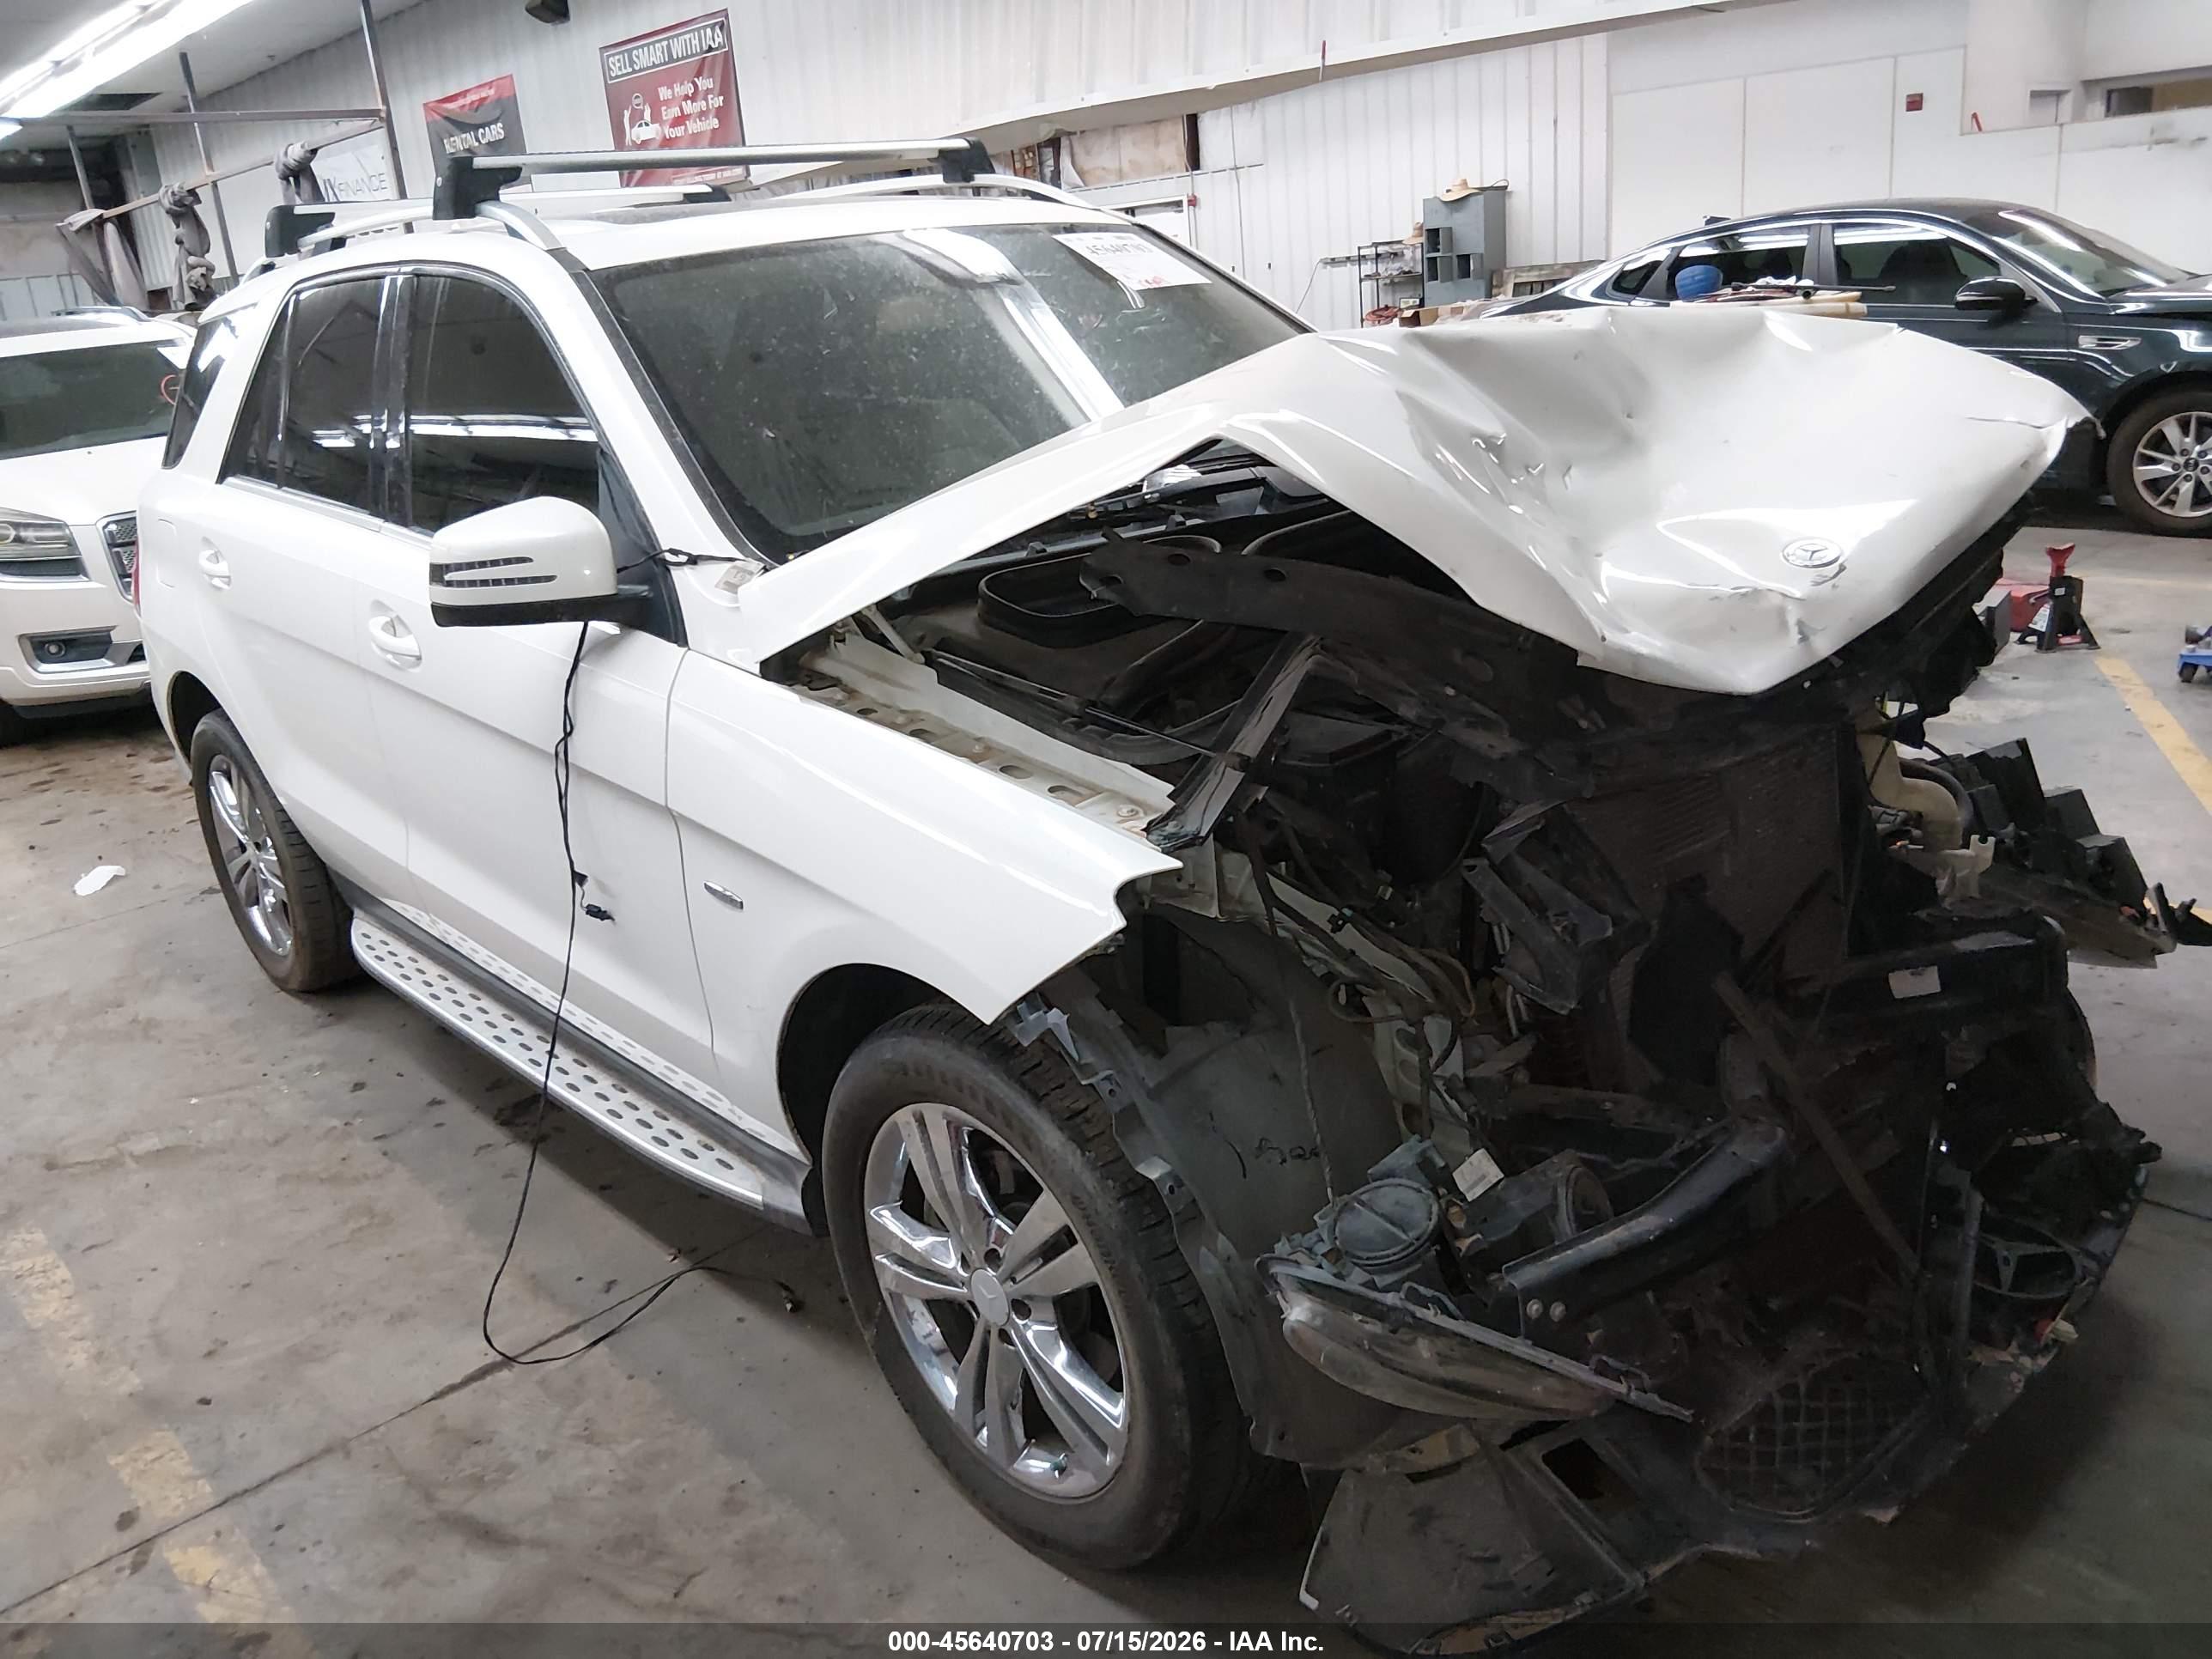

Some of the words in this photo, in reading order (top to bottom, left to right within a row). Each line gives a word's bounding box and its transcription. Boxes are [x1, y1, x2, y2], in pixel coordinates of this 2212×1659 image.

[608, 53, 633, 77] SELL
[632, 40, 669, 70] SMART
[669, 31, 701, 59] WITH
[700, 25, 724, 51] IAA
[657, 87, 672, 101] We
[673, 82, 695, 97] Help
[694, 76, 714, 92] You
[660, 105, 682, 120] Earn
[681, 100, 707, 114] More
[708, 94, 724, 108] For
[443, 131, 479, 155] RENTAL
[477, 122, 505, 144] CARS
[663, 123, 686, 140] Your
[685, 116, 720, 134] Vehicle
